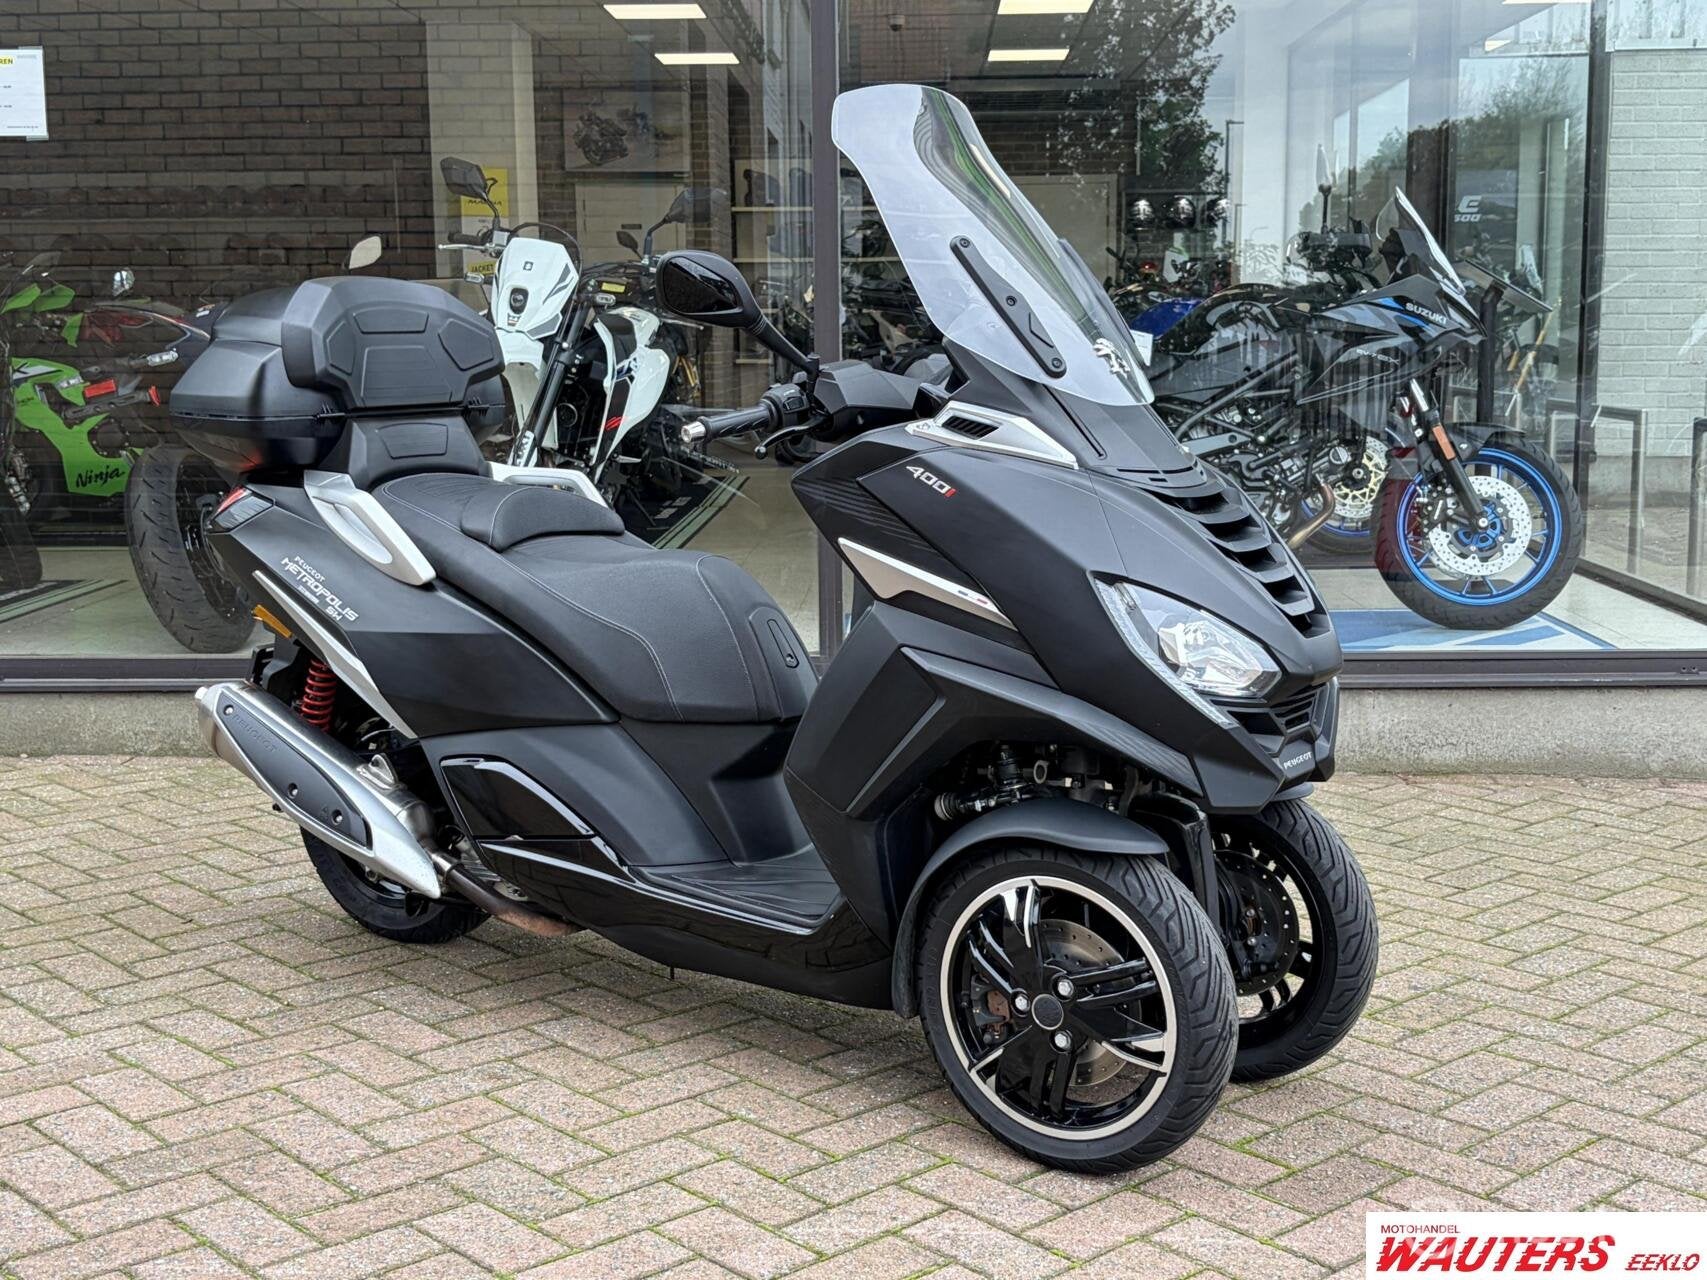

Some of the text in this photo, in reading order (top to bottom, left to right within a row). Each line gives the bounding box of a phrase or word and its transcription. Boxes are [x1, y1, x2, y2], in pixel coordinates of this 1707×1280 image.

[1405, 302, 1447, 325] SUZUKI
[76, 465, 126, 488] Ninja
[294, 555, 326, 582] PEUGEOT
[281, 557, 359, 621] METROPOLIS
[325, 605, 344, 621] SW
[1283, 751, 1312, 770] PEUGEOT
